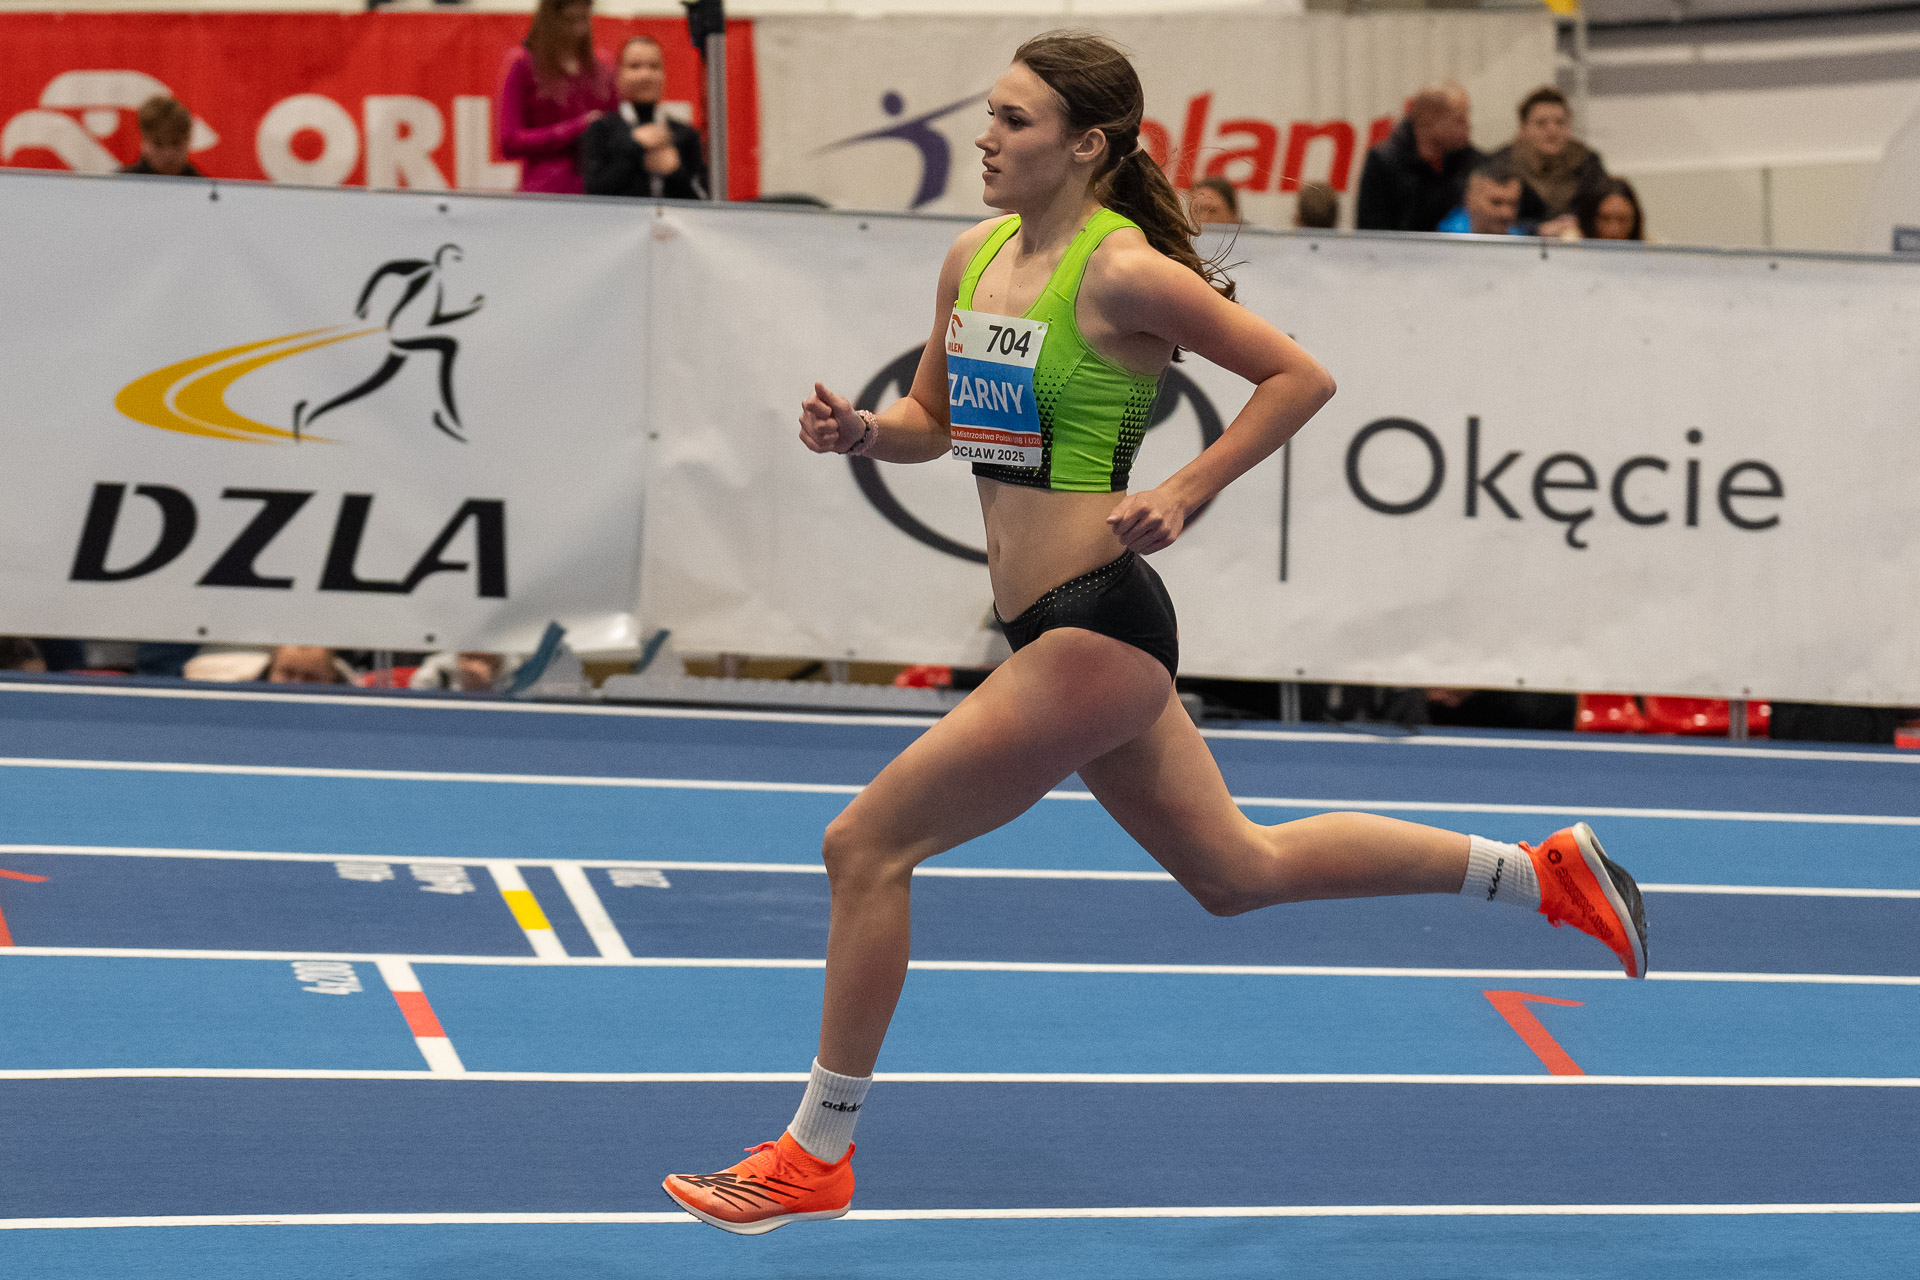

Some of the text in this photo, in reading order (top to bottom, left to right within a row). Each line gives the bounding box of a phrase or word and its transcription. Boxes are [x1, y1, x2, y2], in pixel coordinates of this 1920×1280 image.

[986, 325, 1032, 358] 704
[957, 430, 995, 441] Mistrzostwa
[998, 449, 1025, 462] 2025
[1344, 415, 1785, 550] Okęcie
[68, 482, 508, 599] DZLA
